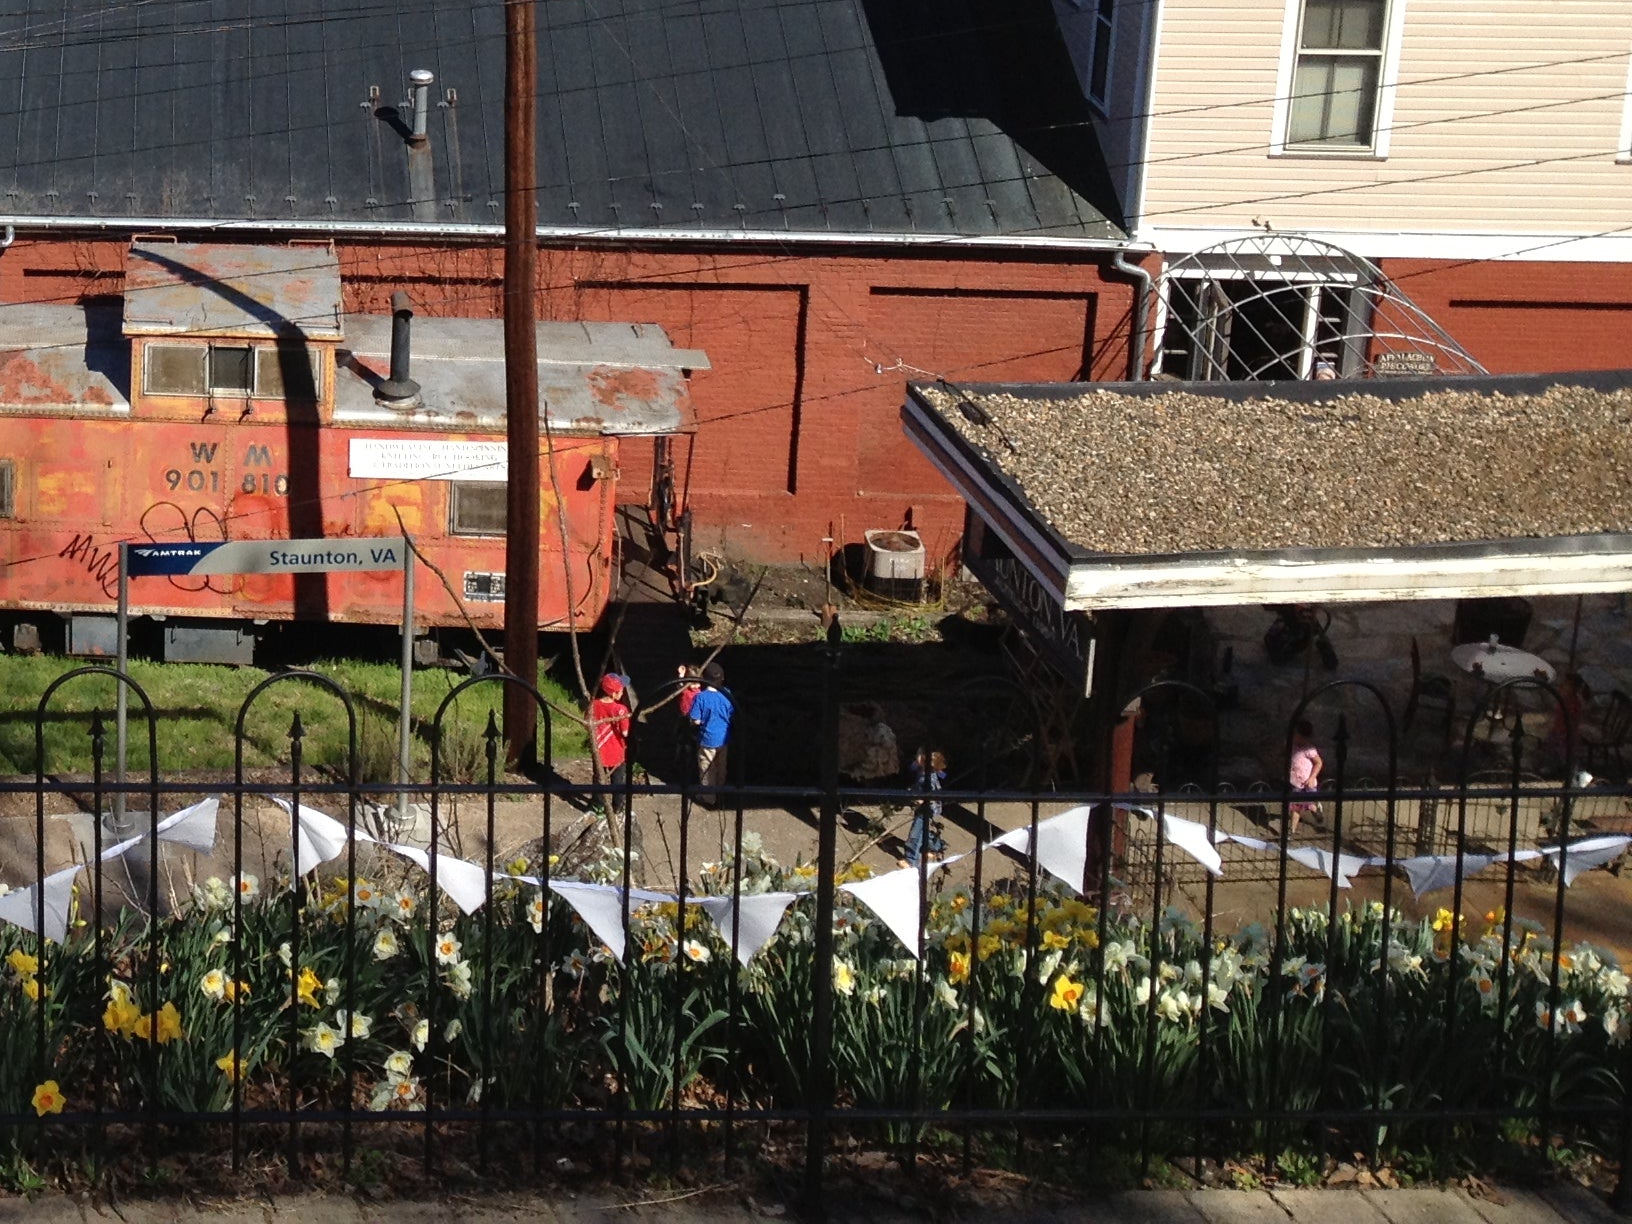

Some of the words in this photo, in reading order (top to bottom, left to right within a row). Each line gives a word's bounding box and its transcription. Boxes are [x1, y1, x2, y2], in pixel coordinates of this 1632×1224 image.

[190, 442, 218, 464] W
[243, 444, 273, 467] M
[165, 469, 219, 493] 901
[241, 472, 290, 496] 810
[152, 548, 202, 557] AMTRAK
[270, 549, 363, 566] Staunton,
[371, 548, 397, 564] VA
